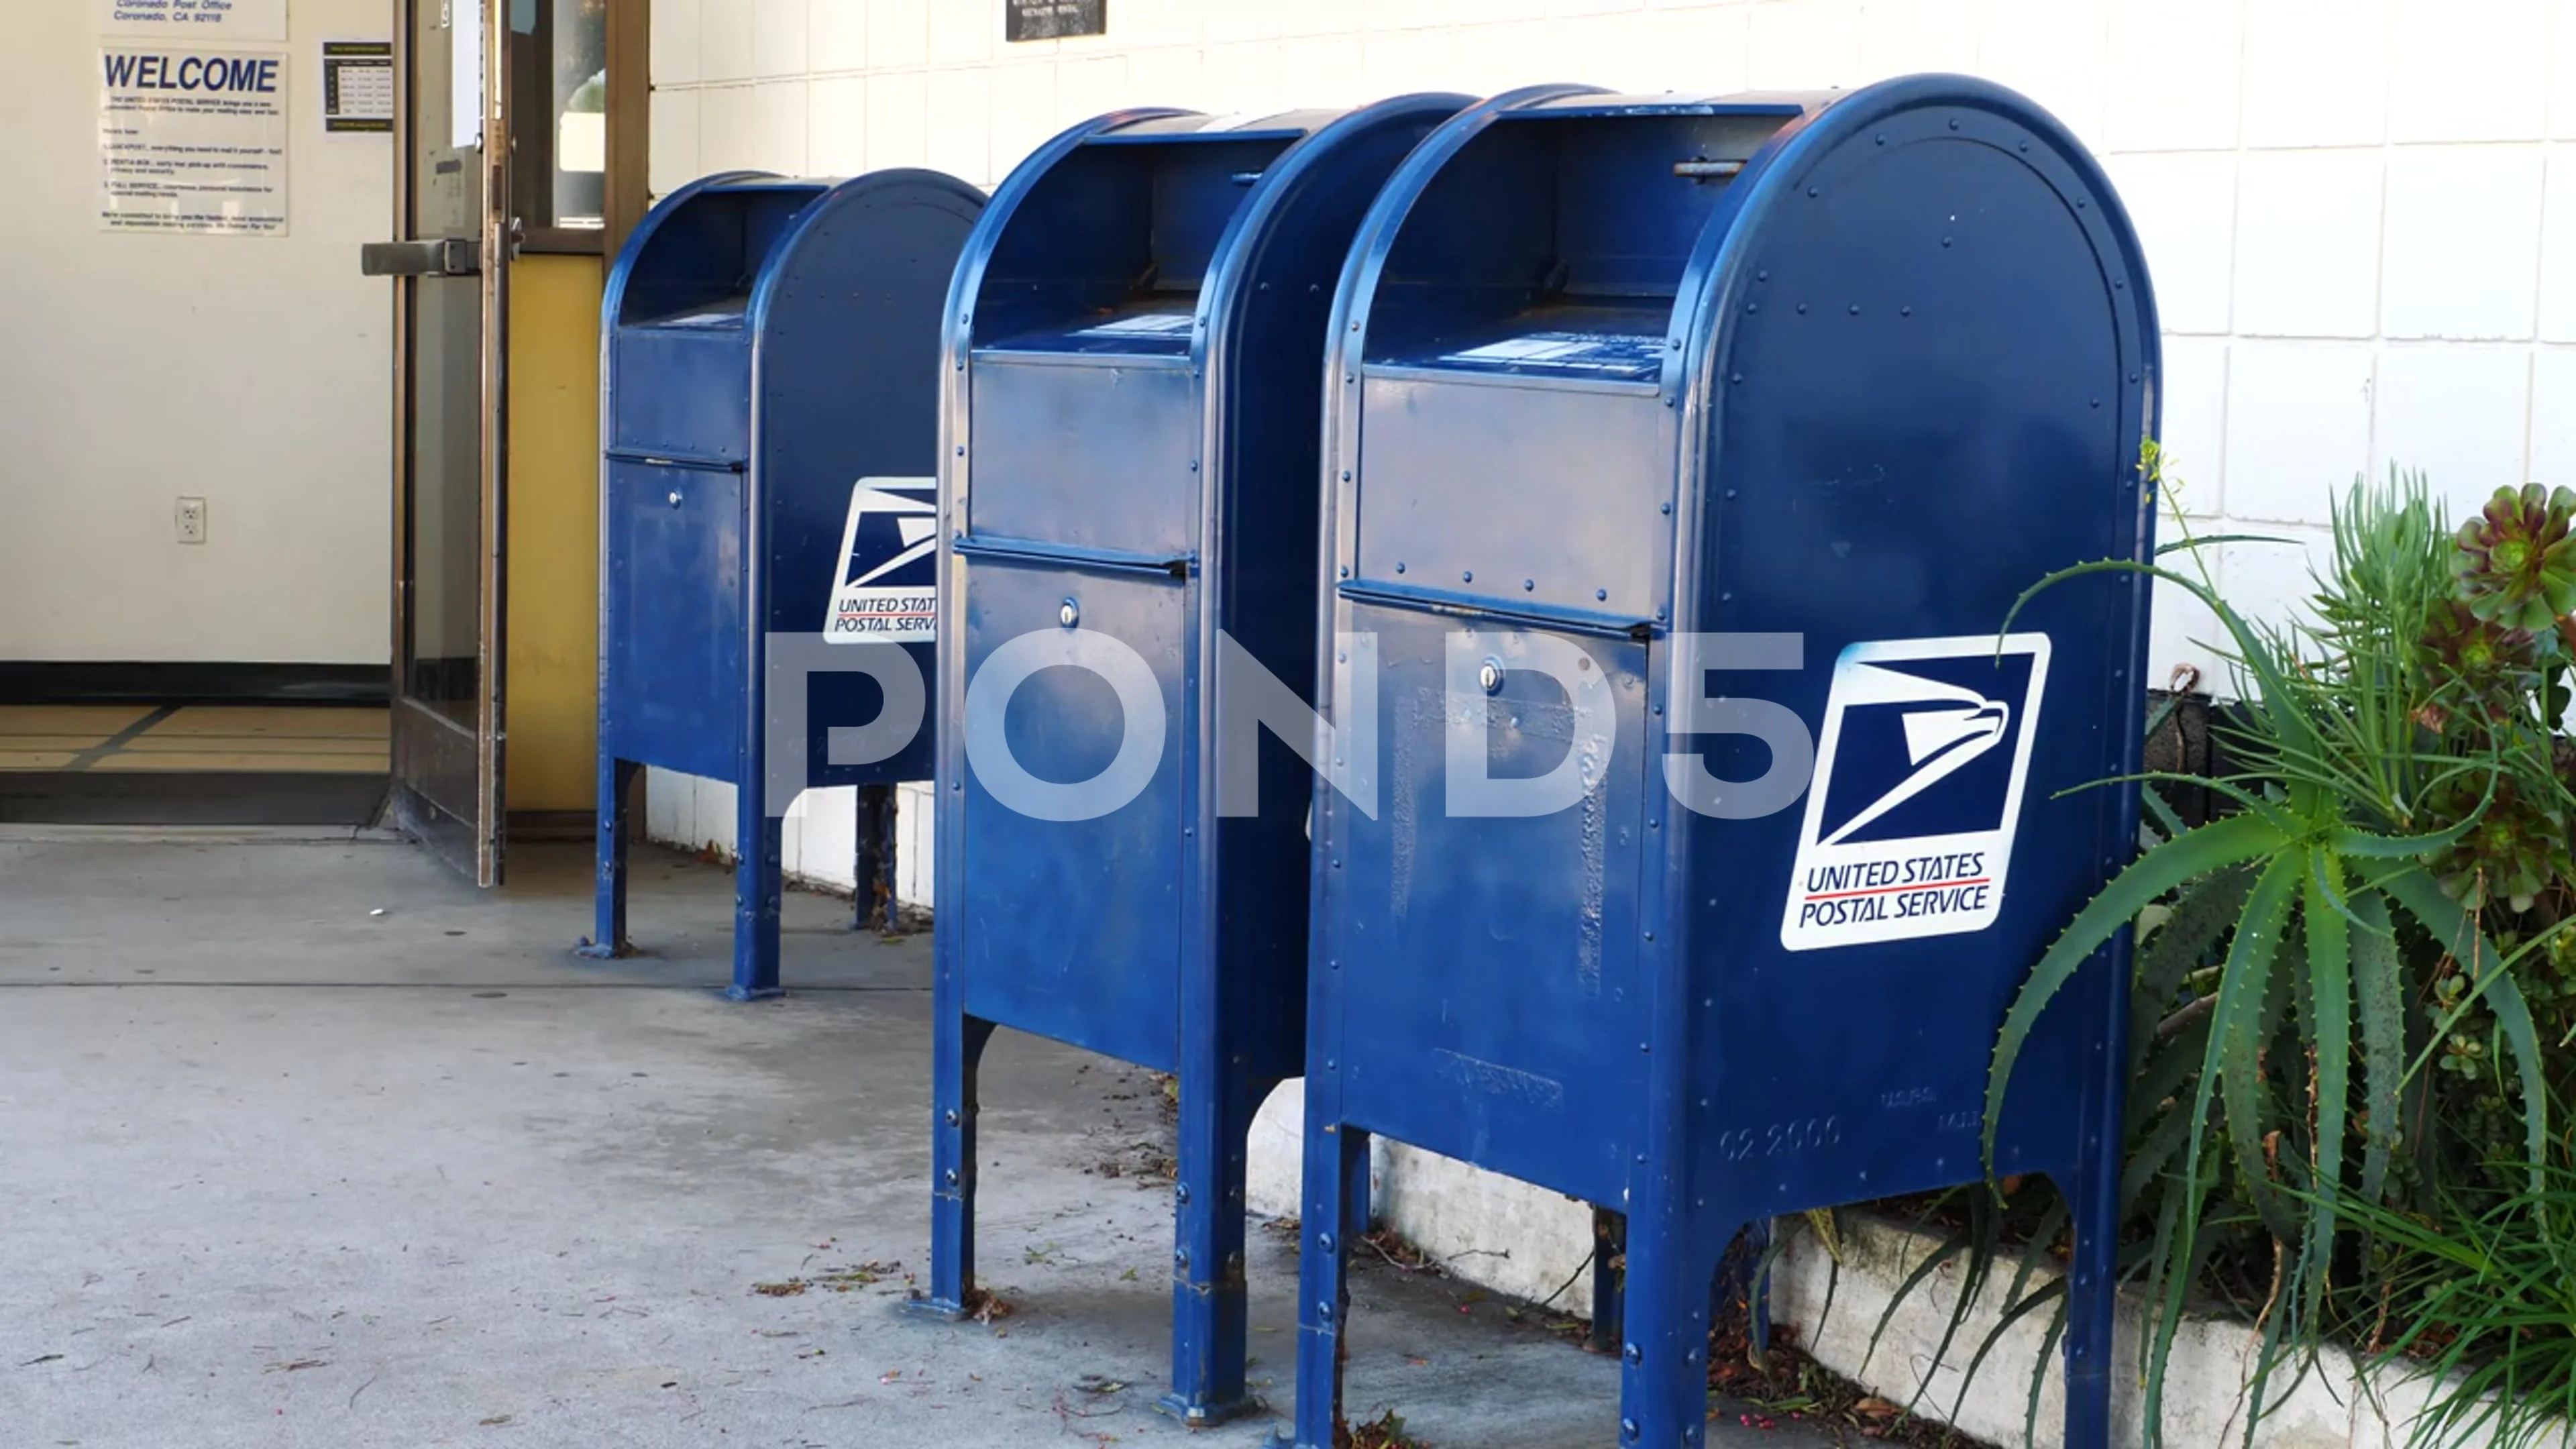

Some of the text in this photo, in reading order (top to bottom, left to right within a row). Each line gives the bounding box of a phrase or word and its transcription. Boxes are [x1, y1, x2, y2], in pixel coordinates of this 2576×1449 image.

[113, 10, 168, 21] Coronado,
[172, 12, 189, 21] CA
[116, 0, 232, 10] Coronado Post Office
[105, 54, 279, 93] WELCOME
[839, 596, 936, 612] UNITED STAT
[835, 616, 936, 632] POSTAL SERV
[1807, 851, 1984, 893] UNITED STATES
[1799, 885, 1990, 928] POSTAL SERVICE
[1719, 1114, 1841, 1161] 02 2000
